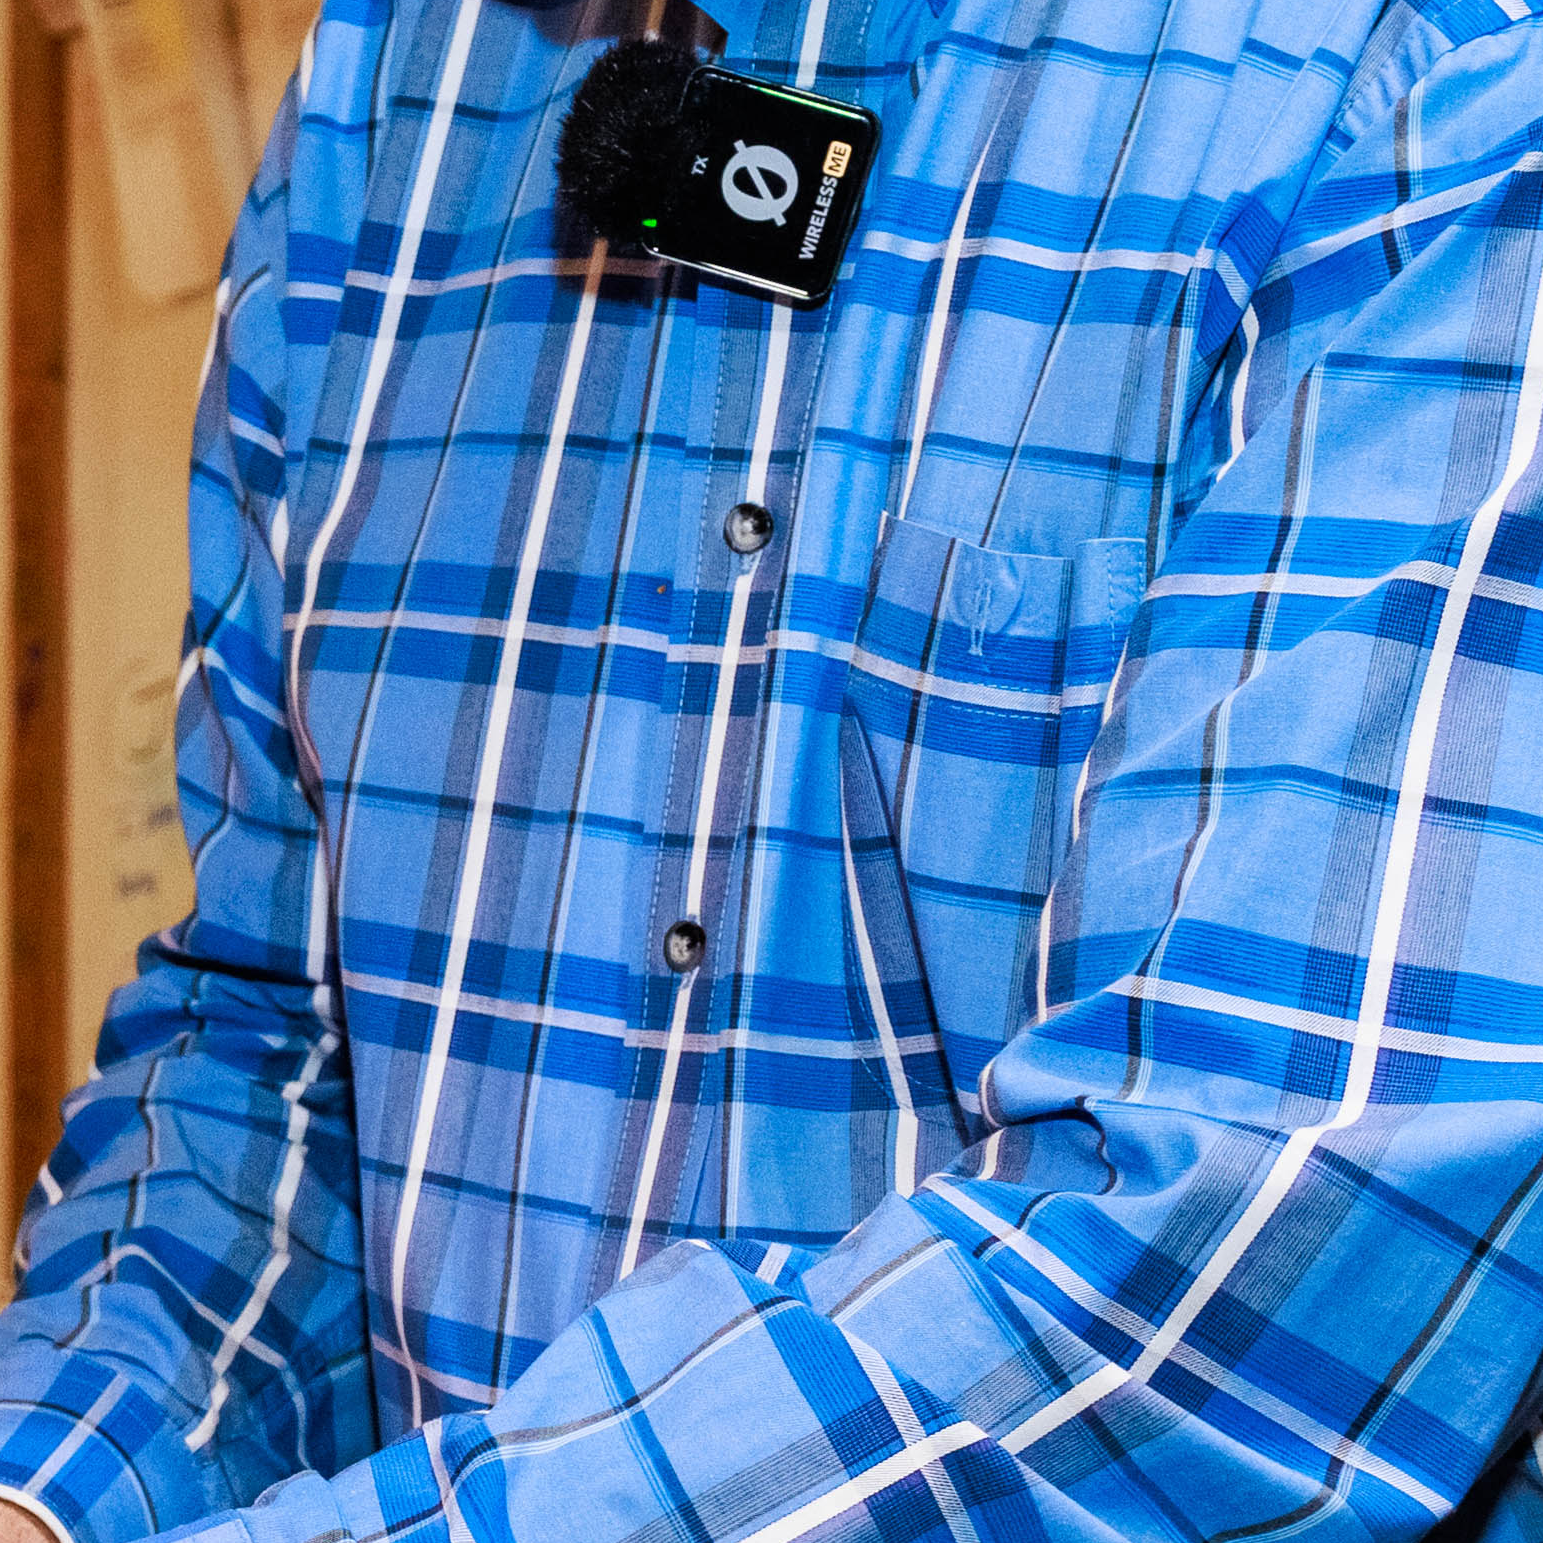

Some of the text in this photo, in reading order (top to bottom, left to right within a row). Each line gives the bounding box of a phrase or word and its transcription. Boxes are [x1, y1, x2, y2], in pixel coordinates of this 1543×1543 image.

[691, 154, 709, 175] TX
[798, 145, 847, 259] WIRELESS ME
